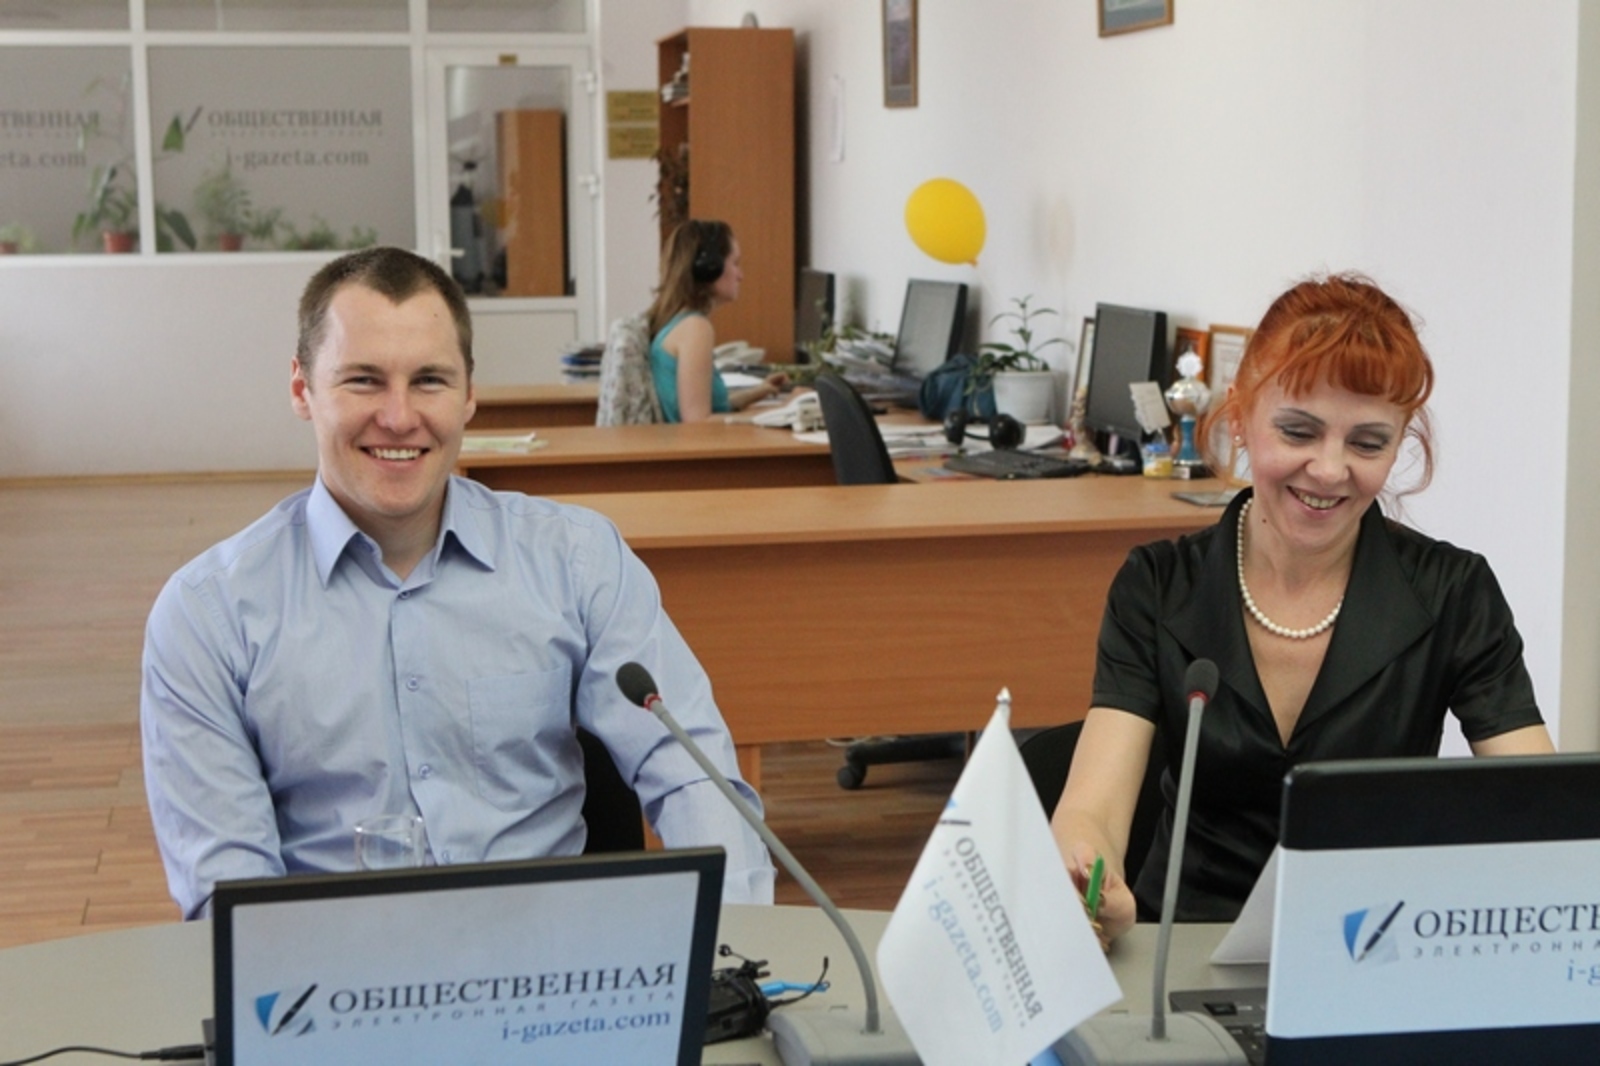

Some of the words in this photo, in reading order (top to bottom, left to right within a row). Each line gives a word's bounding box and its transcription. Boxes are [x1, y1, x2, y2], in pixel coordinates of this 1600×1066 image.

[207, 109, 383, 128] ОБЩЕСТВЕННАЯ
[226, 147, 370, 170] i-gazeta.com
[955, 837, 1043, 1020] ОБЩЕСТВЕННАЯ
[923, 875, 1004, 1034] i-gazeta.com
[329, 962, 677, 1014] ОБЩЕСТВЕННАЯ
[502, 1011, 671, 1043] i-gazeta.com
